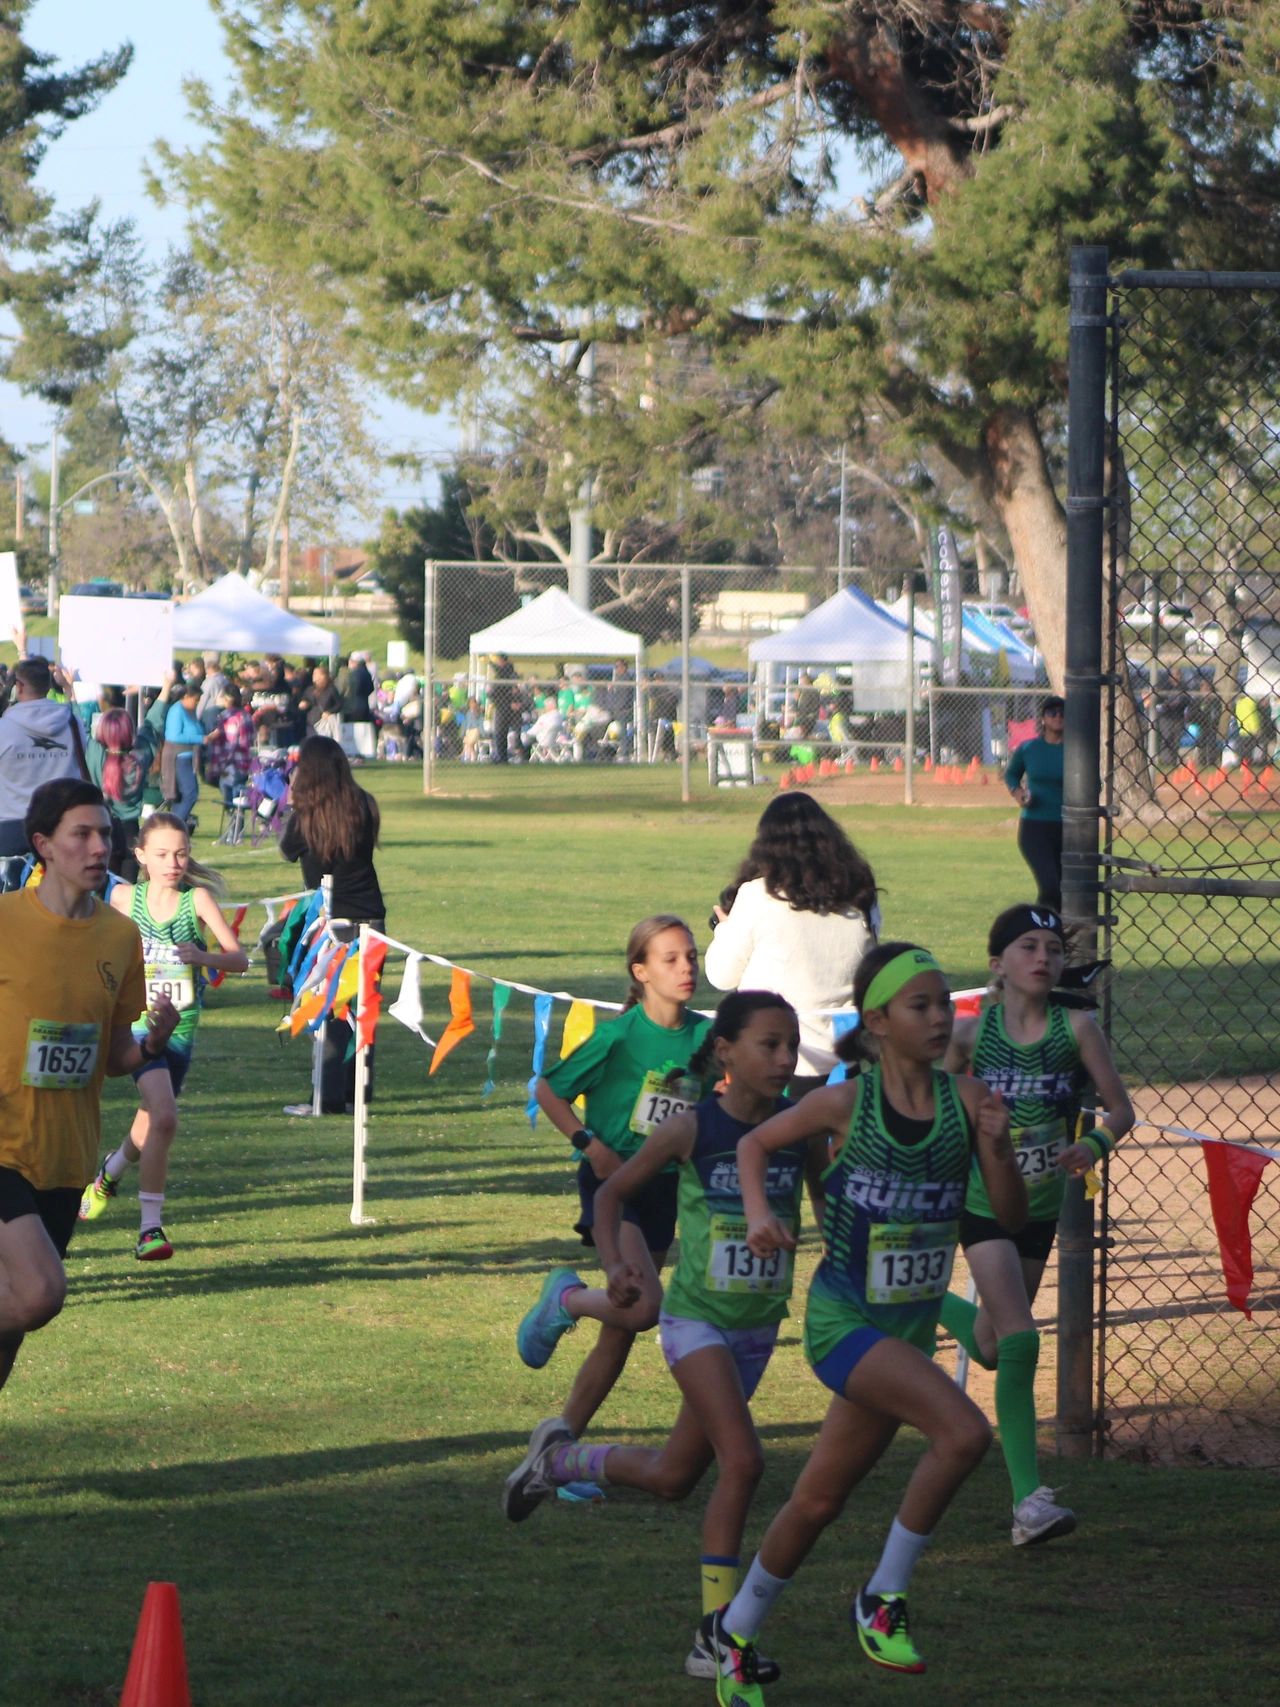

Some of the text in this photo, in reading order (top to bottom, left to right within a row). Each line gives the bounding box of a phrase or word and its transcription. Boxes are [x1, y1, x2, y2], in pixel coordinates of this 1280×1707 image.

[37, 1045, 92, 1074] 1652
[854, 1166, 903, 1181] SoCal
[846, 1173, 964, 1210] QUICK
[882, 1251, 946, 1286] 1333
